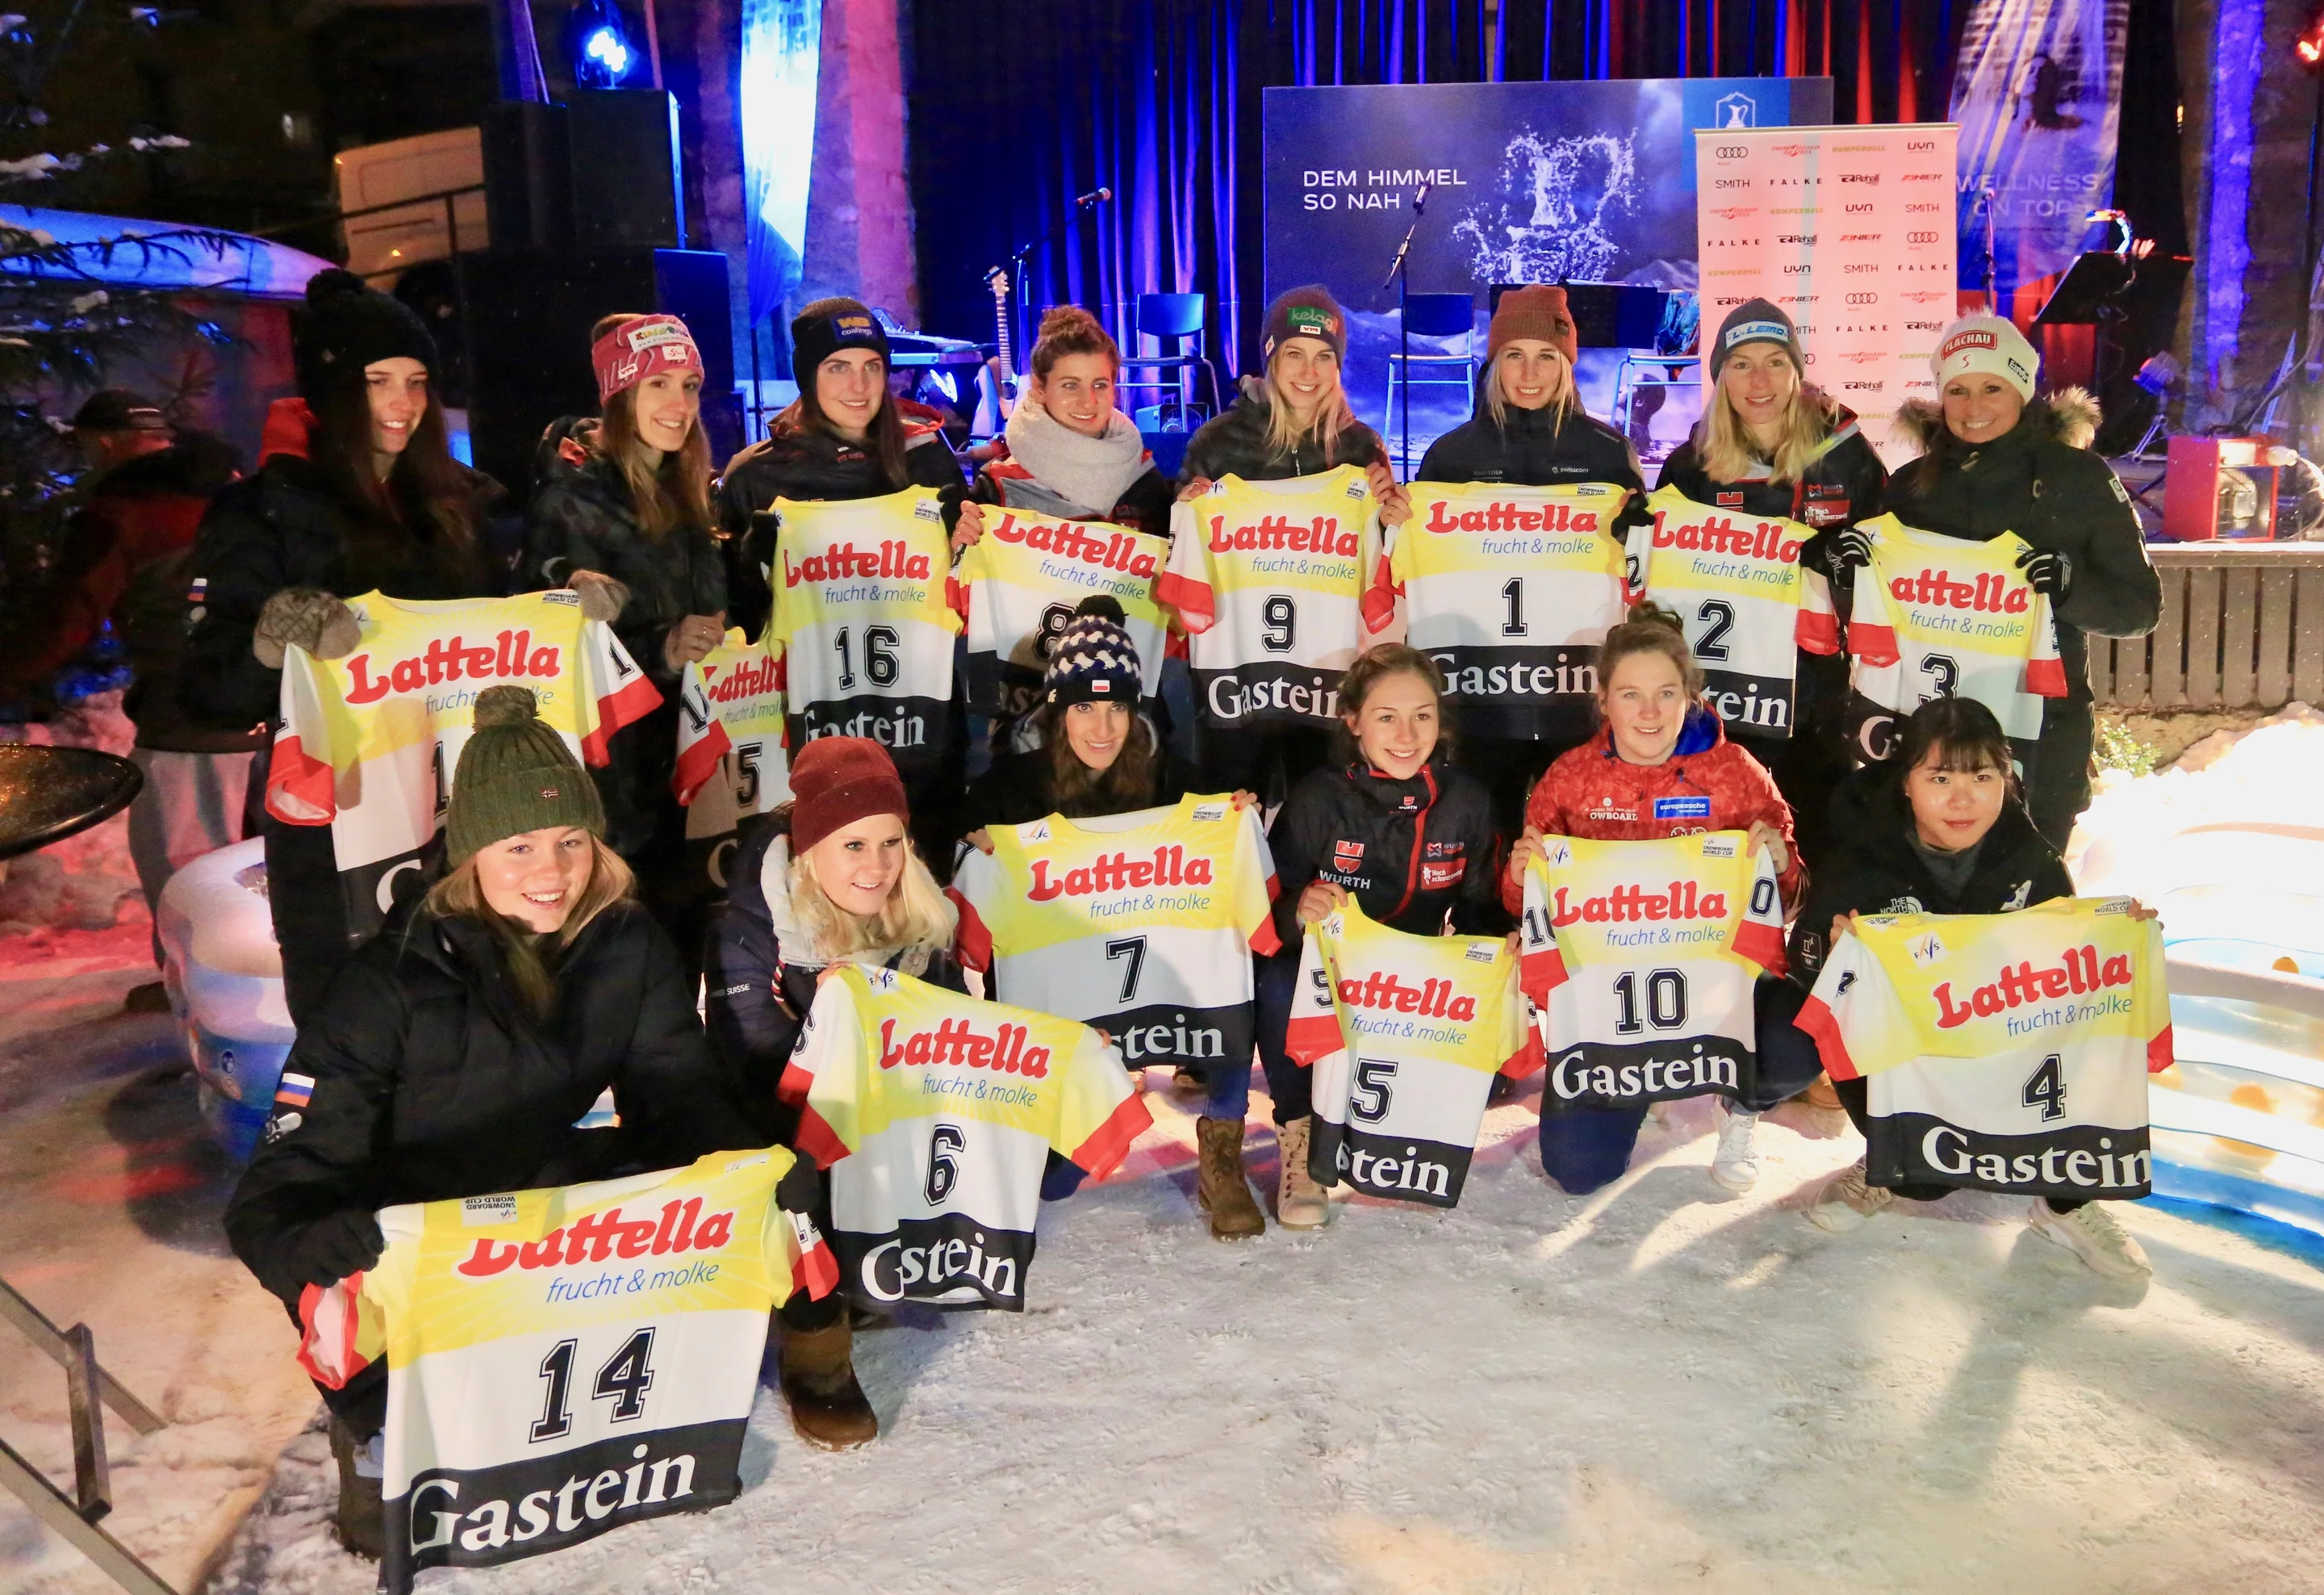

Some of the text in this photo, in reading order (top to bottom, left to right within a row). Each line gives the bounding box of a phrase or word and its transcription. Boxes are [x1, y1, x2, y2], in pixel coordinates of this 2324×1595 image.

[1303, 168, 1467, 187] DEM HIMMEL
[1716, 179, 1750, 188] SMITH
[1770, 178, 1822, 186] FALKE
[1303, 191, 1400, 211] SO NAH
[1905, 203, 1940, 212] SMITH
[1707, 239, 1761, 247] FALKE
[1844, 264, 1879, 274] SMITH
[841, 327, 873, 336] coatings
[1292, 308, 1333, 331] kelag
[1836, 324, 1888, 333] FALKE
[1945, 333, 1991, 353] FLACHAU
[1209, 515, 1359, 557] Lattella
[1425, 501, 1598, 534] Lattella
[993, 513, 1156, 579] Lattella
[1482, 538, 1594, 555] frucht & molke
[1039, 559, 1145, 600] frucht & molke
[1252, 557, 1356, 580] frucht & molke
[1626, 553, 1643, 589] 2
[1691, 557, 1794, 585] frucht & molke
[825, 585, 926, 605] frucht & molke
[1503, 577, 1528, 637] 1
[1889, 568, 2029, 613] attella
[1262, 594, 1297, 653] 9
[1694, 599, 1735, 662] 2
[1911, 611, 2024, 637] frucht & molke
[345, 630, 560, 705] Lattella
[834, 625, 900, 691] 16
[1918, 652, 1959, 705] 3
[723, 705, 749, 726] frucht
[737, 742, 763, 808] 5
[1590, 812, 1638, 822] OWBOARD
[1659, 802, 1706, 812] europeesche
[1027, 844, 1212, 902] Lattella
[1090, 893, 1210, 919] frucht & molke
[1551, 880, 1728, 928] Lattella
[1880, 904, 1908, 914] NORTH
[1891, 897, 1907, 906] THE
[1607, 925, 1725, 947] frucht & molke
[1106, 935, 1147, 1003] 7
[1933, 944, 2132, 1028] Lattella
[726, 982, 750, 995] SUISSE
[1337, 971, 1476, 1022] attella
[1613, 968, 1690, 1036] 10
[1350, 1015, 1467, 1045] frucht & molke
[2007, 994, 2133, 1038] frucht & molke
[880, 1018, 1050, 1078] Lattella
[1552, 1043, 1739, 1099] Gastein
[2021, 1053, 2067, 1122] 4
[922, 1074, 1038, 1107] frucht & molke
[1349, 1057, 1398, 1124] 5
[924, 1124, 966, 1207] 6
[1922, 1125, 2152, 1188] Gastein
[458, 1197, 734, 1277] Lattella
[545, 1261, 720, 1305] frucht & molke
[529, 1326, 658, 1444] 14
[411, 1443, 696, 1556] Gastein
